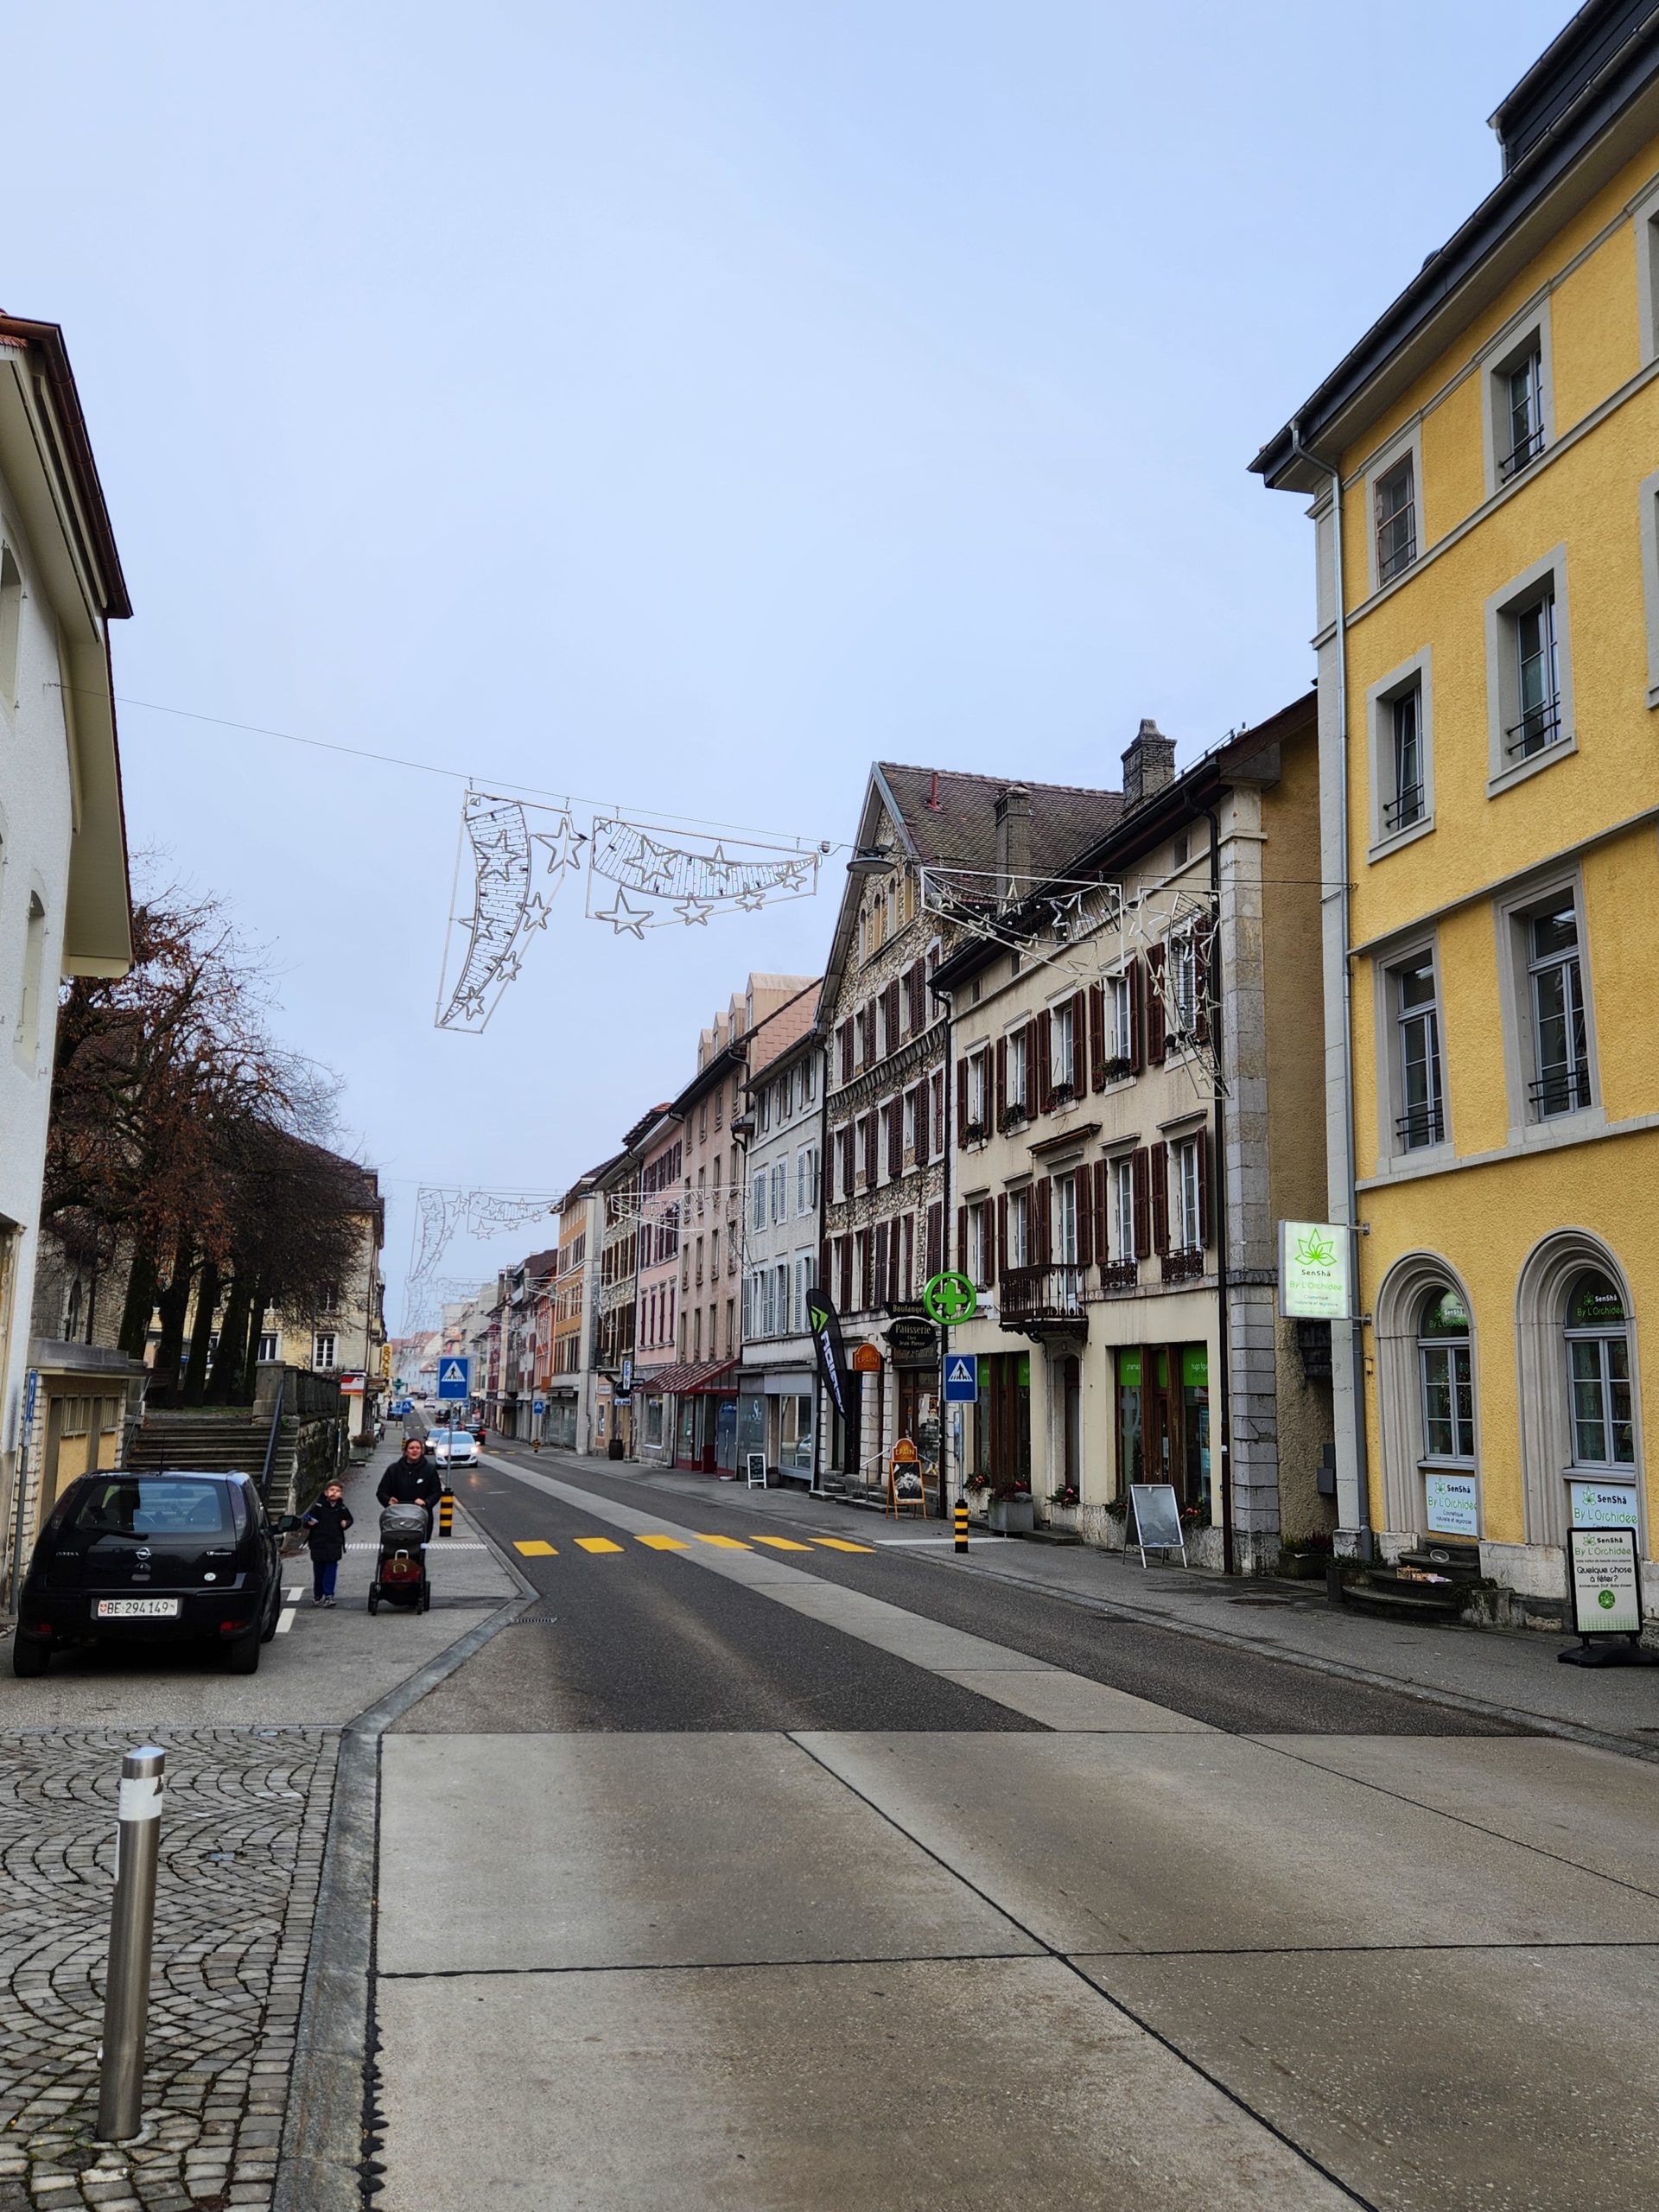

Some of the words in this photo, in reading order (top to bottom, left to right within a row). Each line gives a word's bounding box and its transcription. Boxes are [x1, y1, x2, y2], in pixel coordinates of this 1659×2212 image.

[1289, 1280, 1300, 1289] By
[893, 1304, 927, 1313] Boulanger
[1576, 1307, 1586, 1318] By
[1427, 1496, 1437, 1508] By
[1573, 1507, 1586, 1521] By
[1588, 1508, 1638, 1524] L'Orchidée
[1574, 1548, 1586, 1556] By
[1576, 1566, 1608, 1574] Quelque
